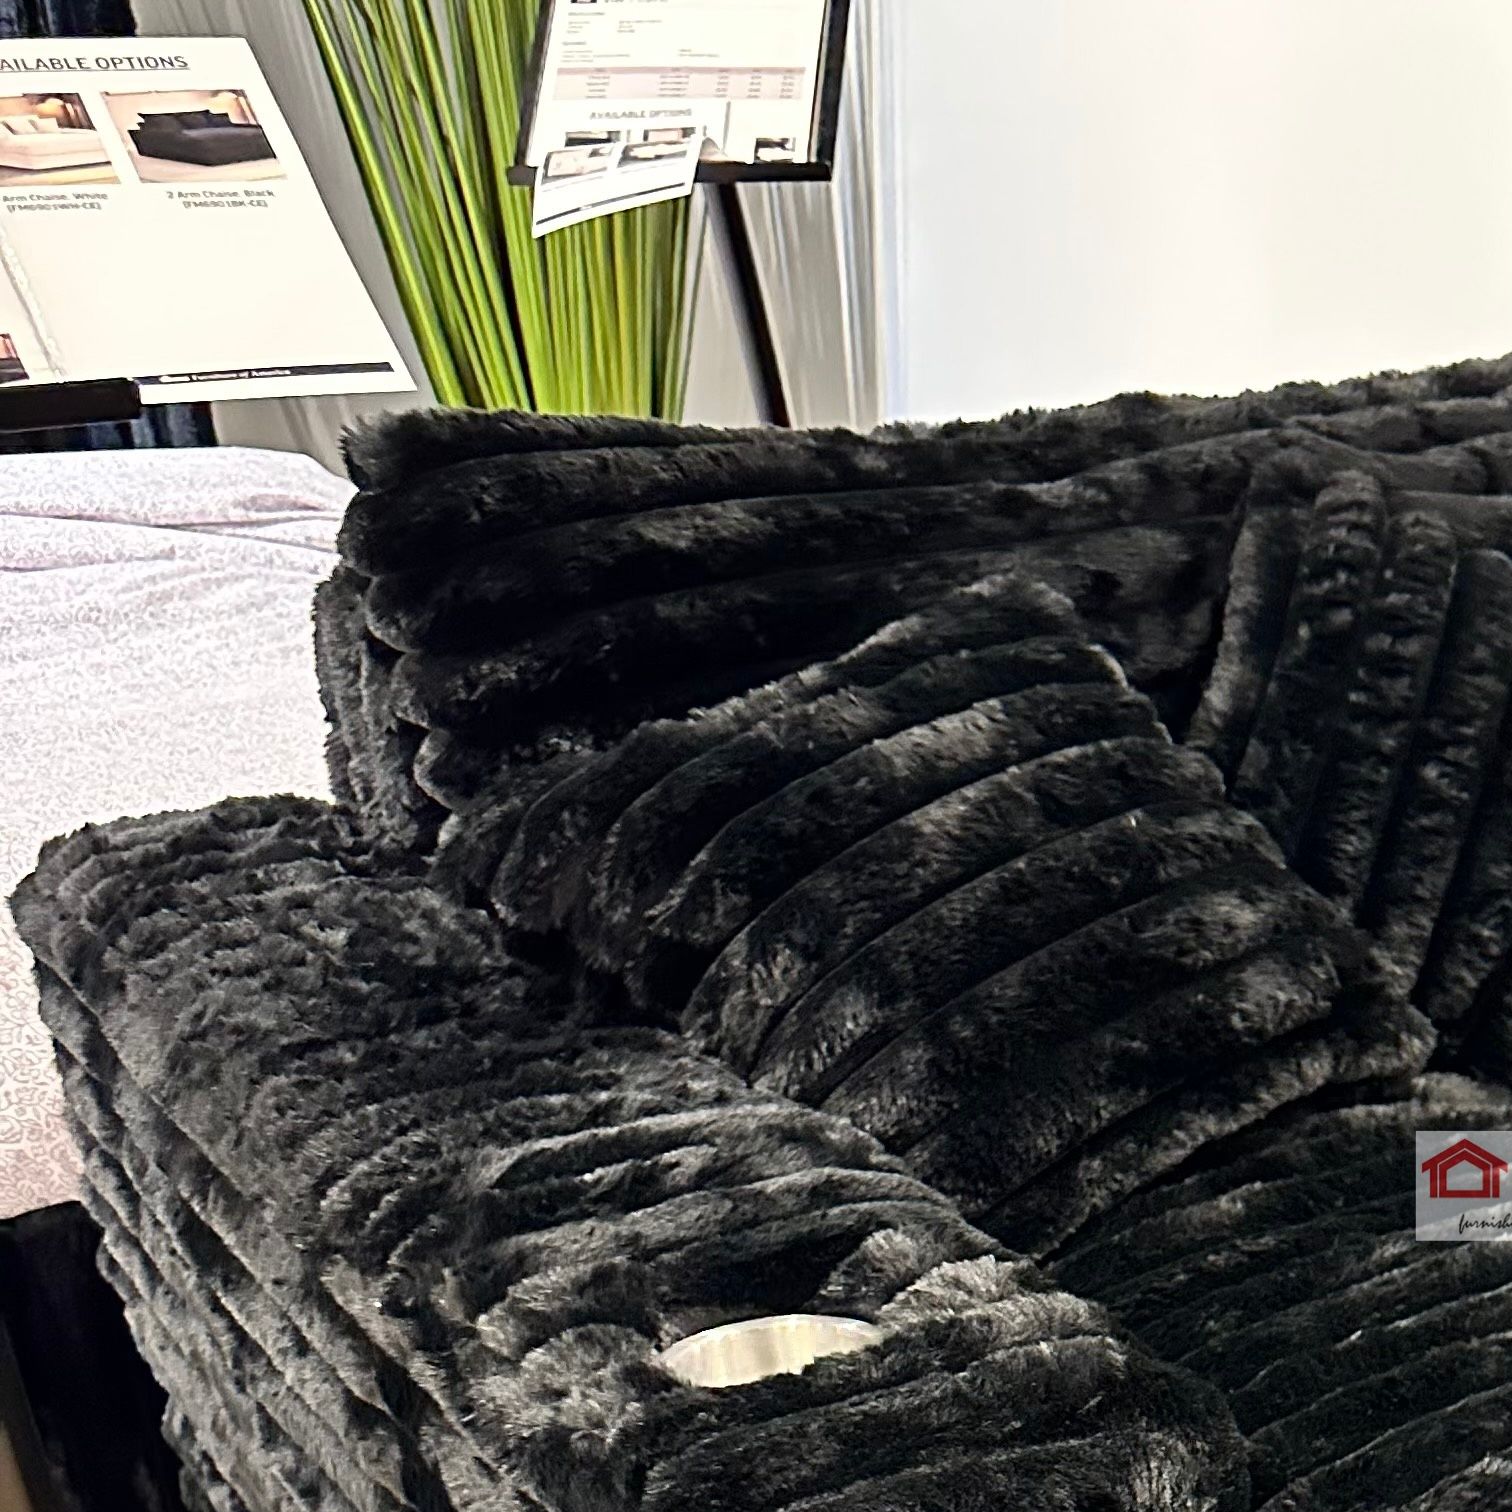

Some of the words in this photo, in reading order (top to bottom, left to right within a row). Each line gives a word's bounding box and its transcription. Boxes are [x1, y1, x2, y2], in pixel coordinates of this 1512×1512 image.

[0, 58, 91, 71] AILABLE
[95, 56, 188, 69] OPTIONS
[589, 111, 646, 120] AVAILABLE
